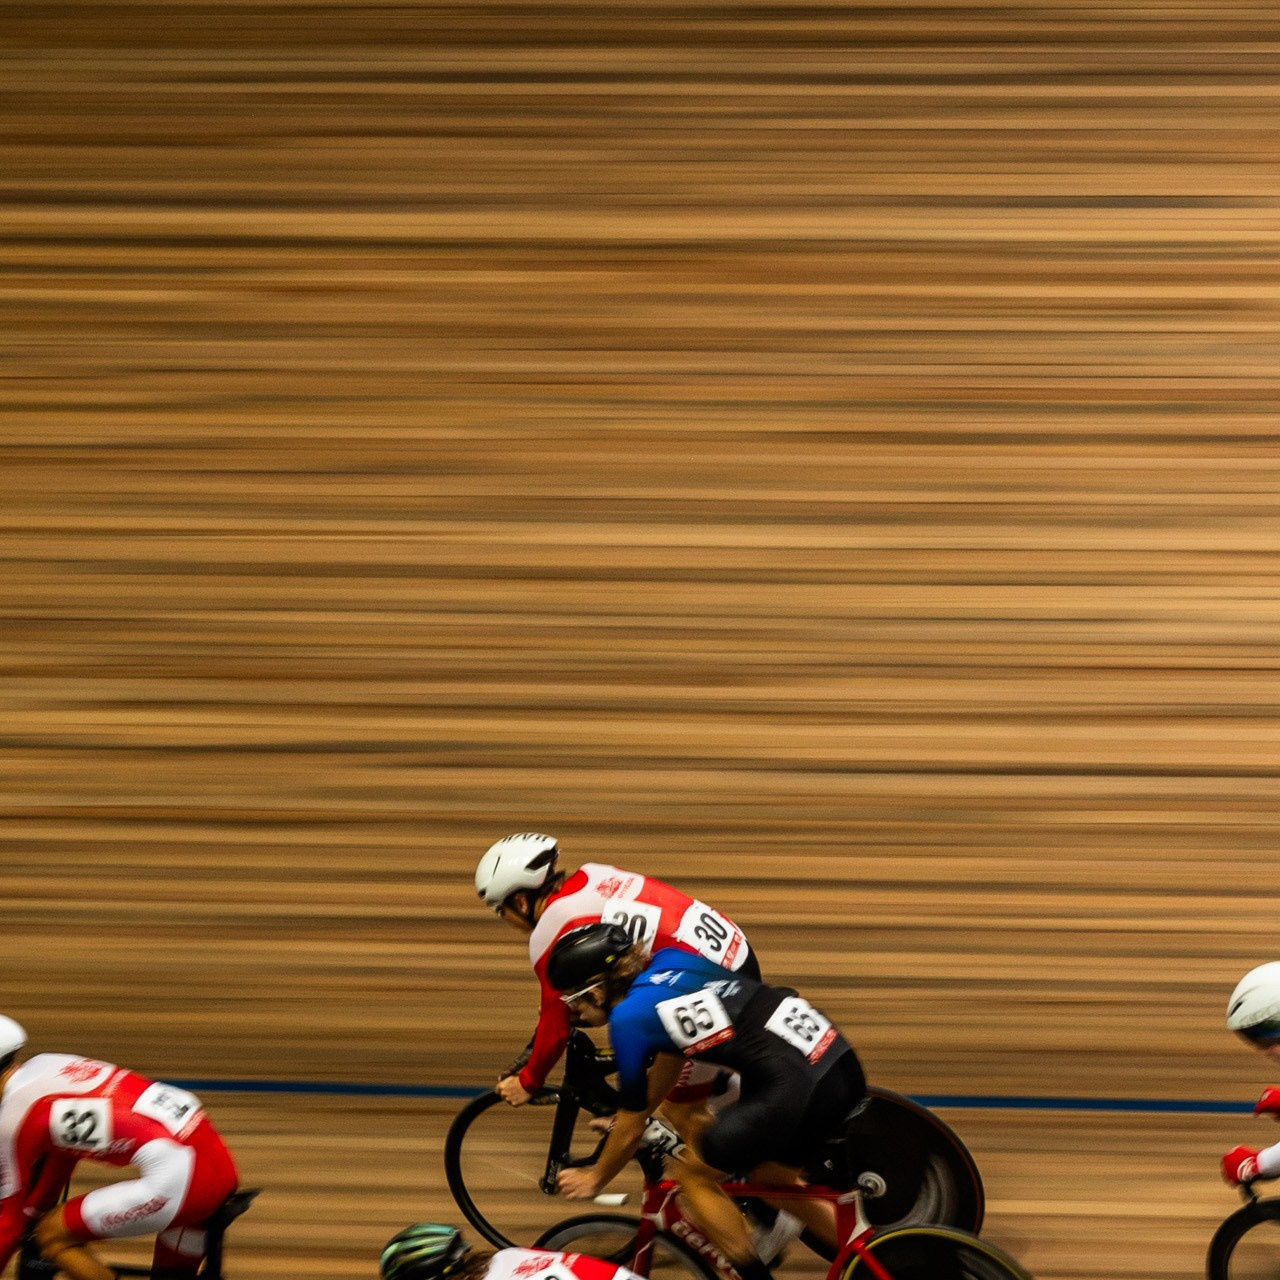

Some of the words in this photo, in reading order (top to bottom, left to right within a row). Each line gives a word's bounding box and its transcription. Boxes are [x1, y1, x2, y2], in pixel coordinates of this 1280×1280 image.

[694, 913, 728, 952] 30
[673, 1000, 714, 1038] 65
[61, 1108, 101, 1145] 32
